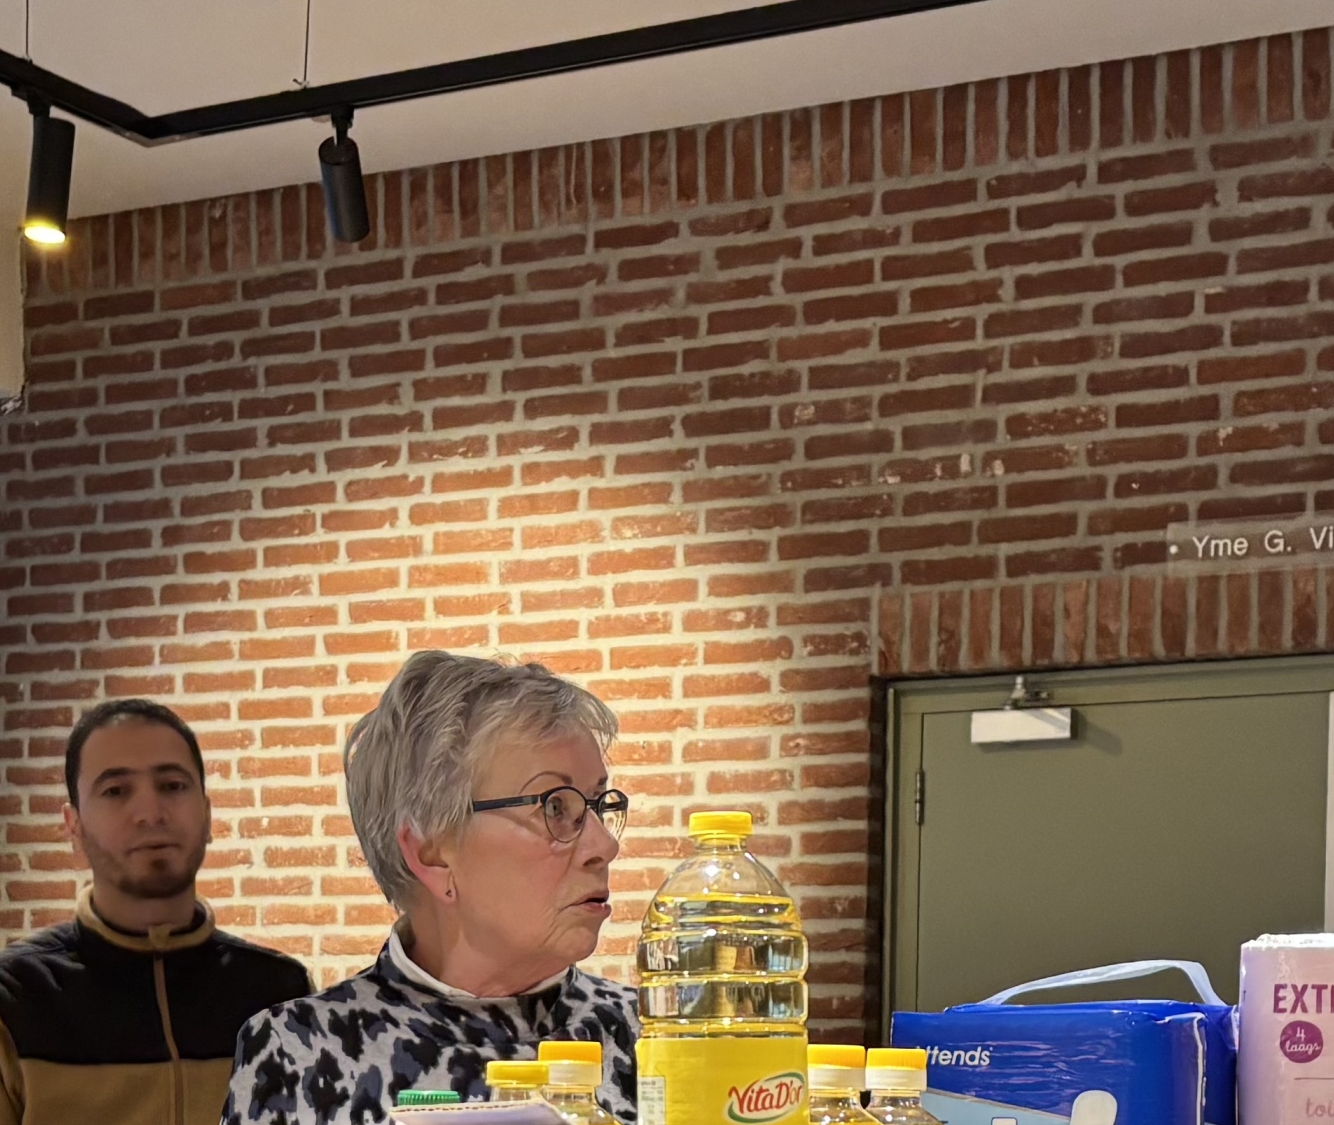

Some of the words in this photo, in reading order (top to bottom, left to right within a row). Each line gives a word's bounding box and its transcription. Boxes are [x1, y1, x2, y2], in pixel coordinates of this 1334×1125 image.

[1192, 535, 1249, 558] Yme
[1264, 529, 1292, 555] G.
[1296, 1026, 1306, 1040] 4
[915, 1045, 990, 1067] ttends
